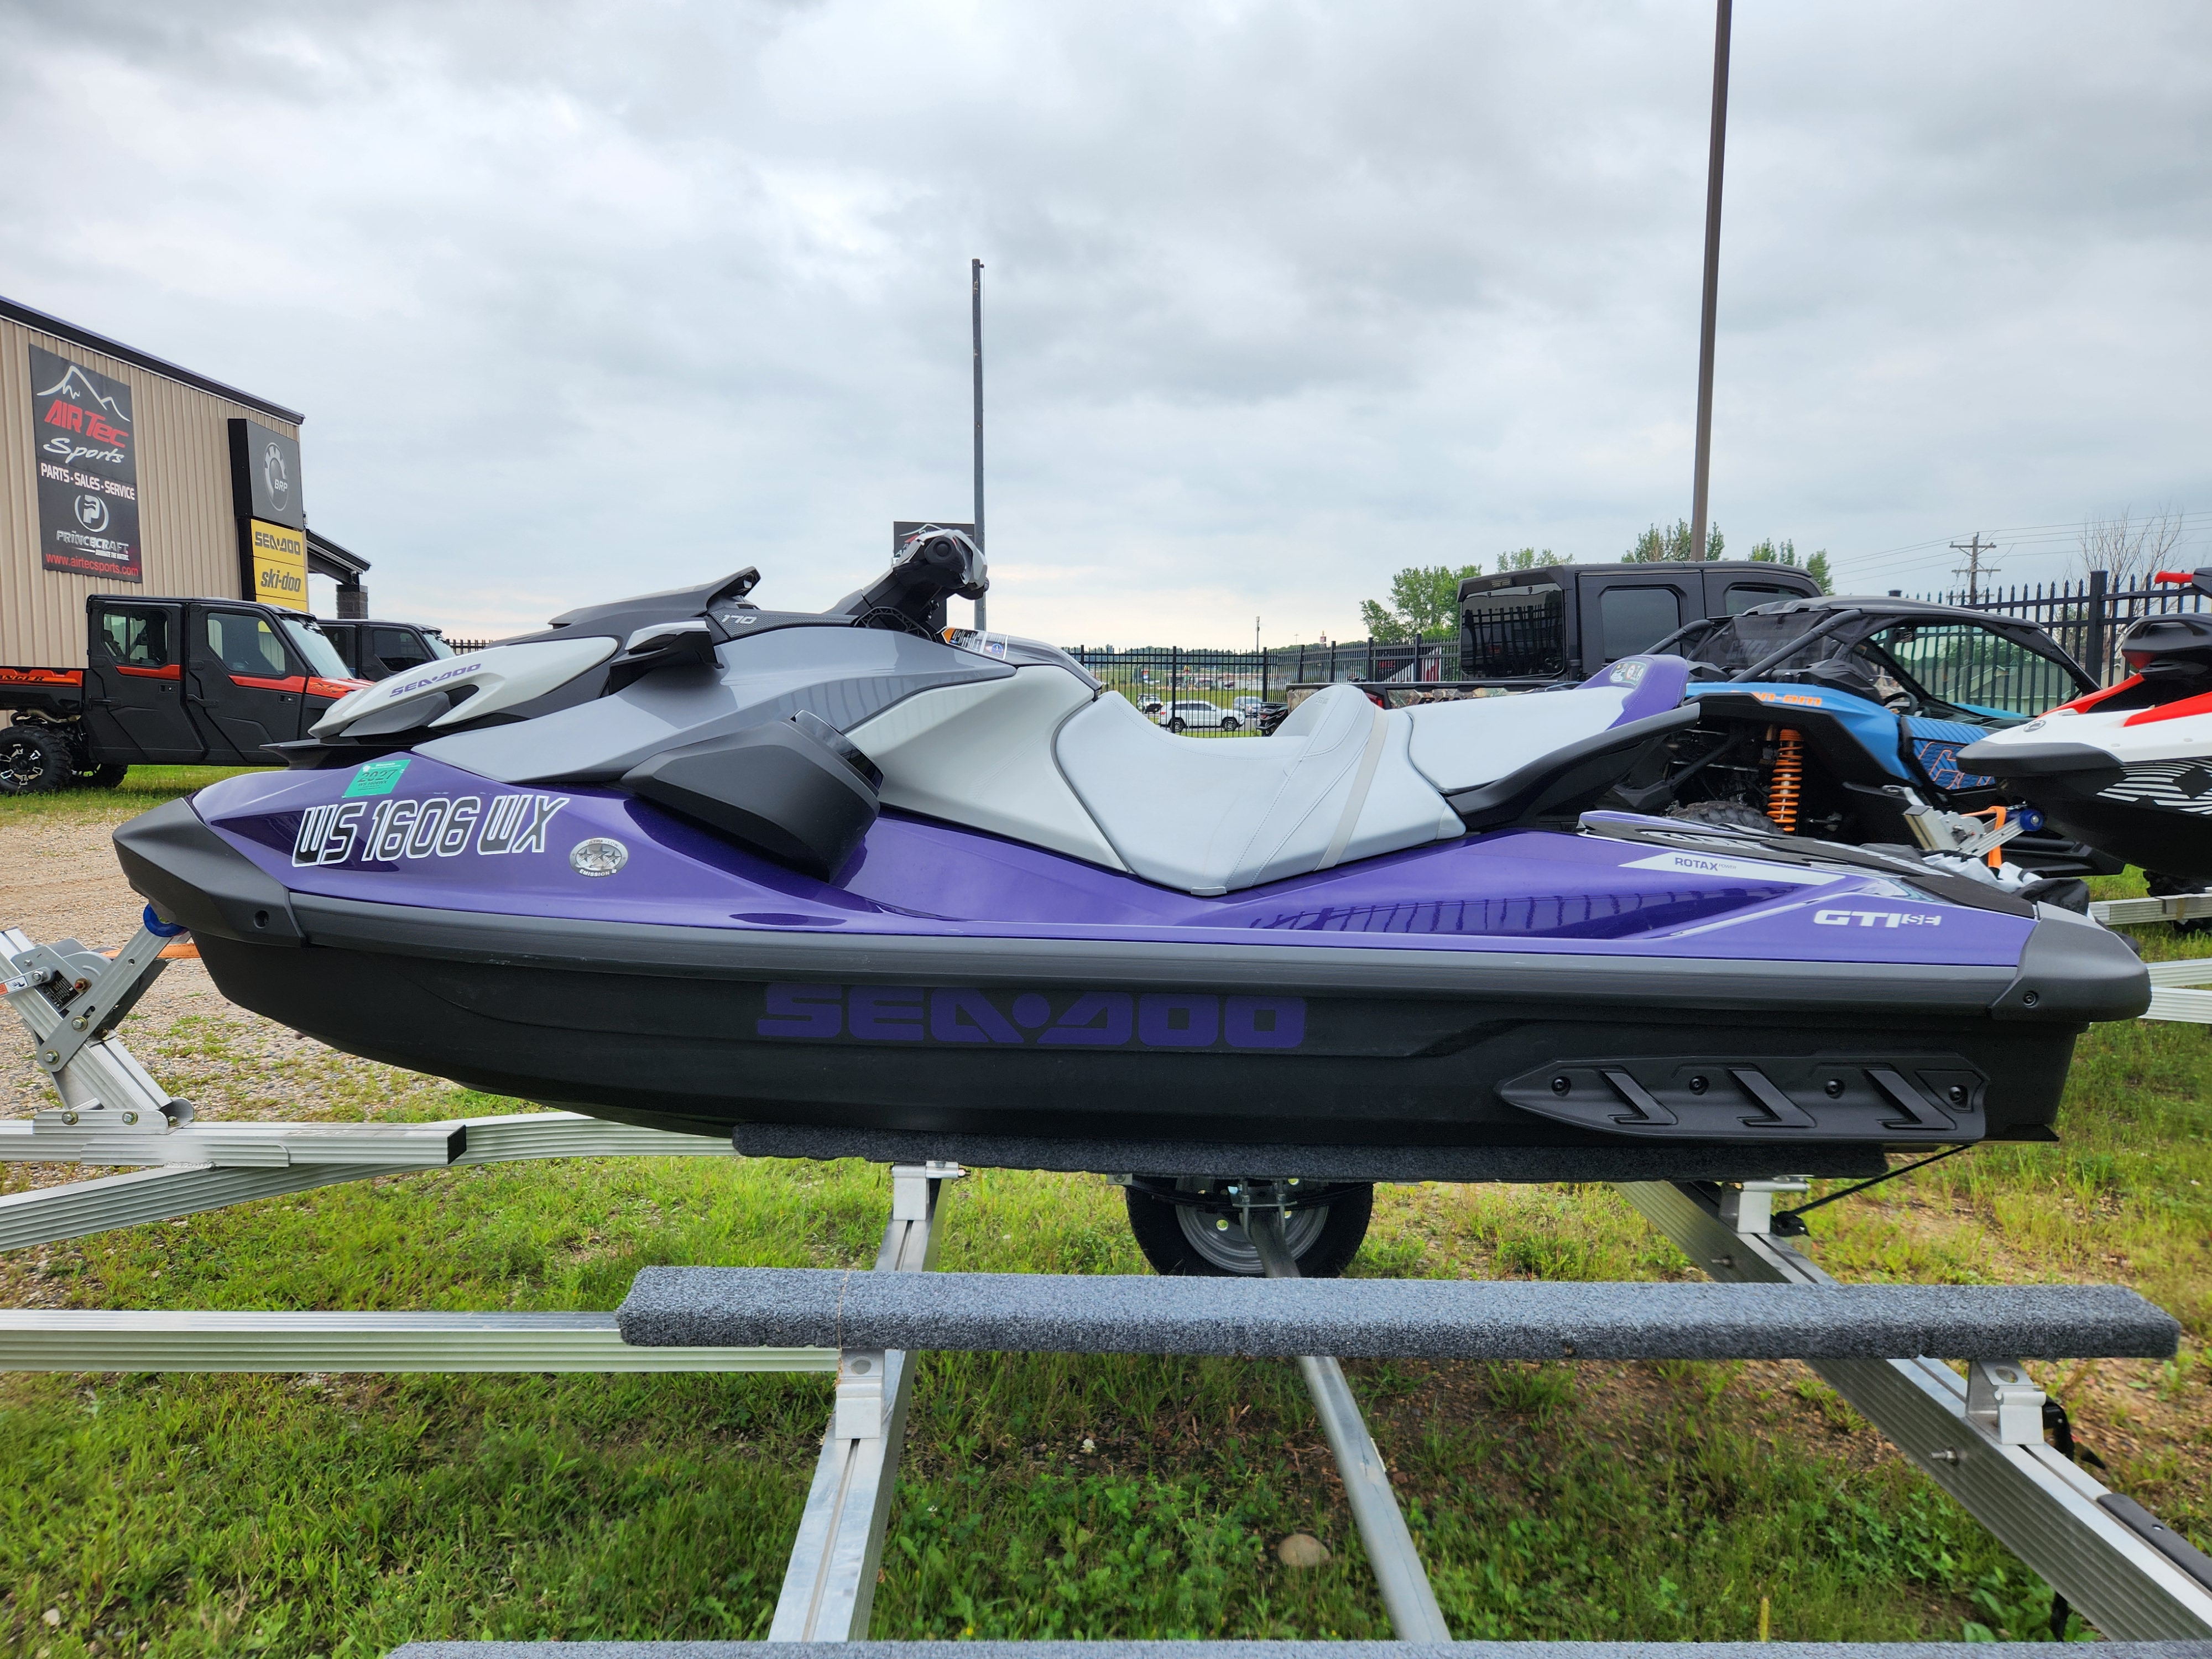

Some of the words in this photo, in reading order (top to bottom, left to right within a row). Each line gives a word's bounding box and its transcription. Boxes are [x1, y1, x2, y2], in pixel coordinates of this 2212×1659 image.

[44, 399, 83, 433] AIR
[43, 437, 125, 463] Sports
[274, 479, 288, 492] BRP
[56, 530, 129, 554] PRINCECRAFT
[46, 554, 138, 577] www.airtecsports.com
[260, 568, 301, 593] ski-doo
[721, 614, 757, 624] 170
[357, 769, 398, 782] 2027
[291, 802, 368, 867] WS
[361, 796, 481, 862] 1606
[477, 794, 570, 855] WX
[1674, 857, 1718, 872] ROTAX
[1813, 909, 1903, 928] GTI
